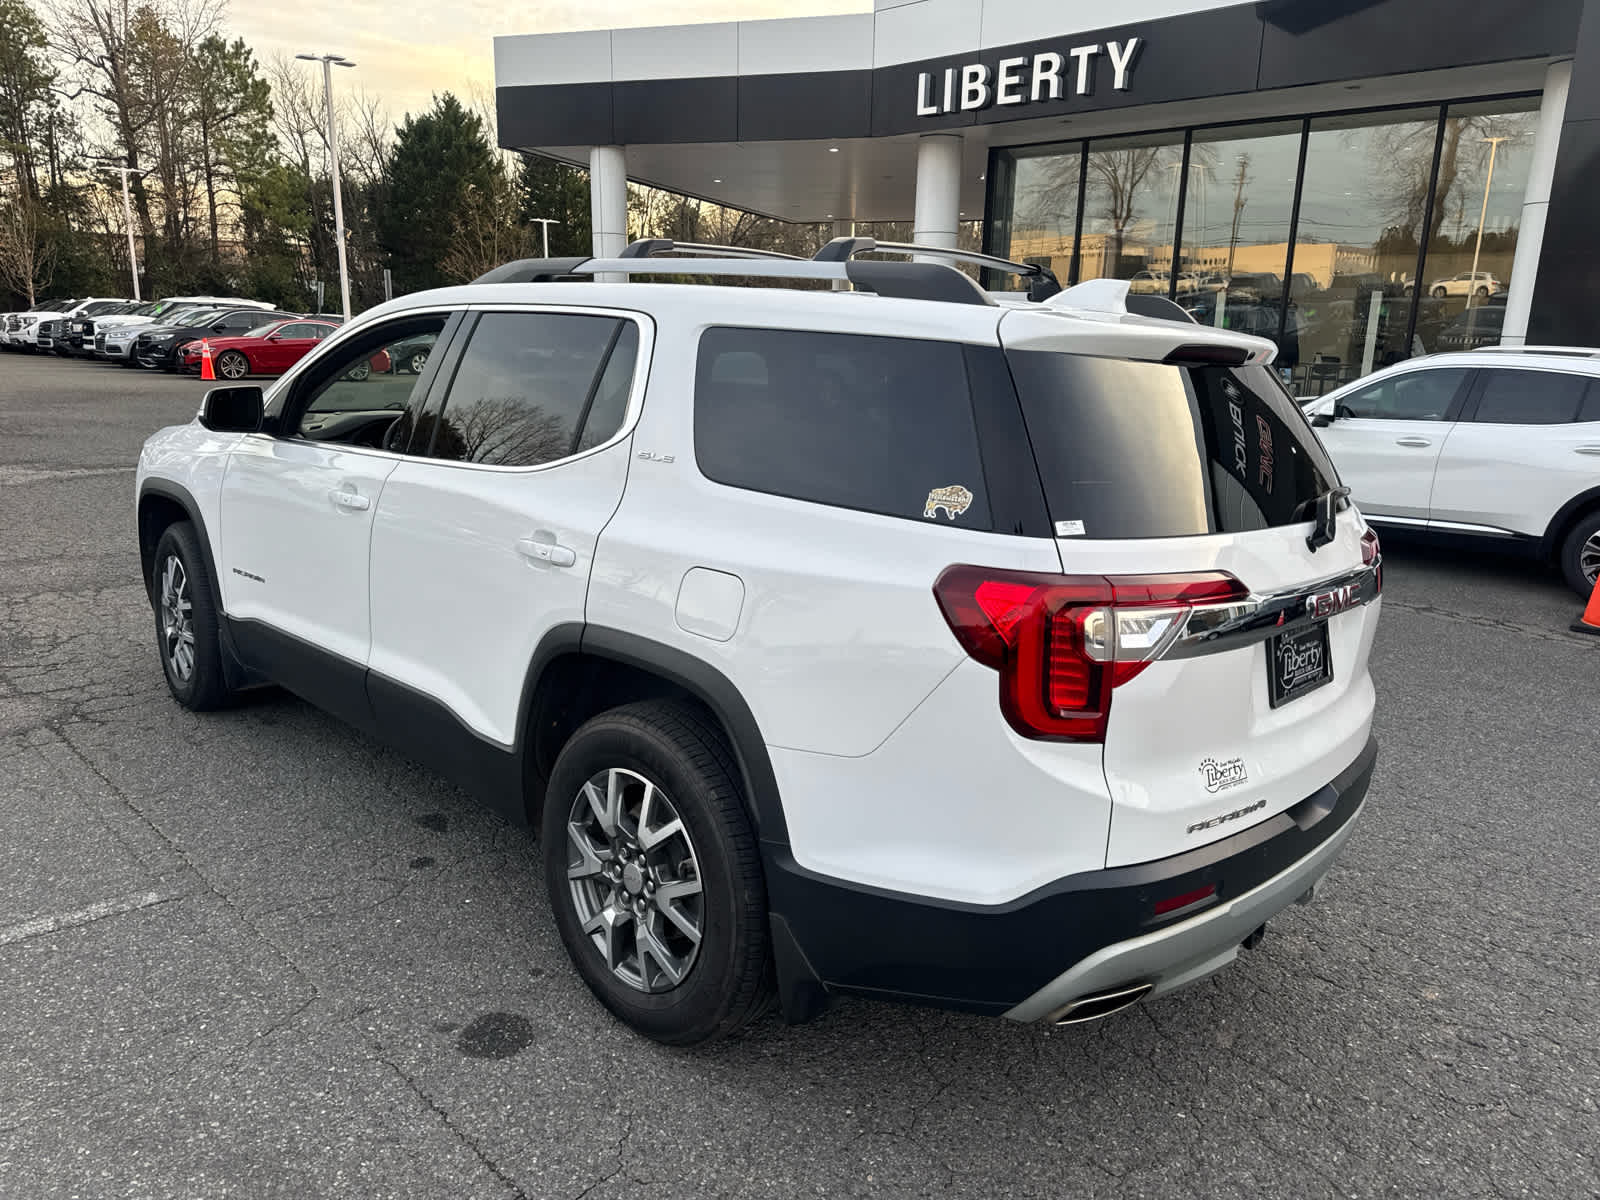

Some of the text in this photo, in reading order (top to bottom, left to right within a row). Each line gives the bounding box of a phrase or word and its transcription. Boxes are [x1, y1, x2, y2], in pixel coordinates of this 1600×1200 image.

[916, 37, 1143, 116] LIBERTY
[1313, 584, 1361, 617] GMC
[1283, 646, 1322, 680] Liberty
[1206, 762, 1244, 788] Liberty
